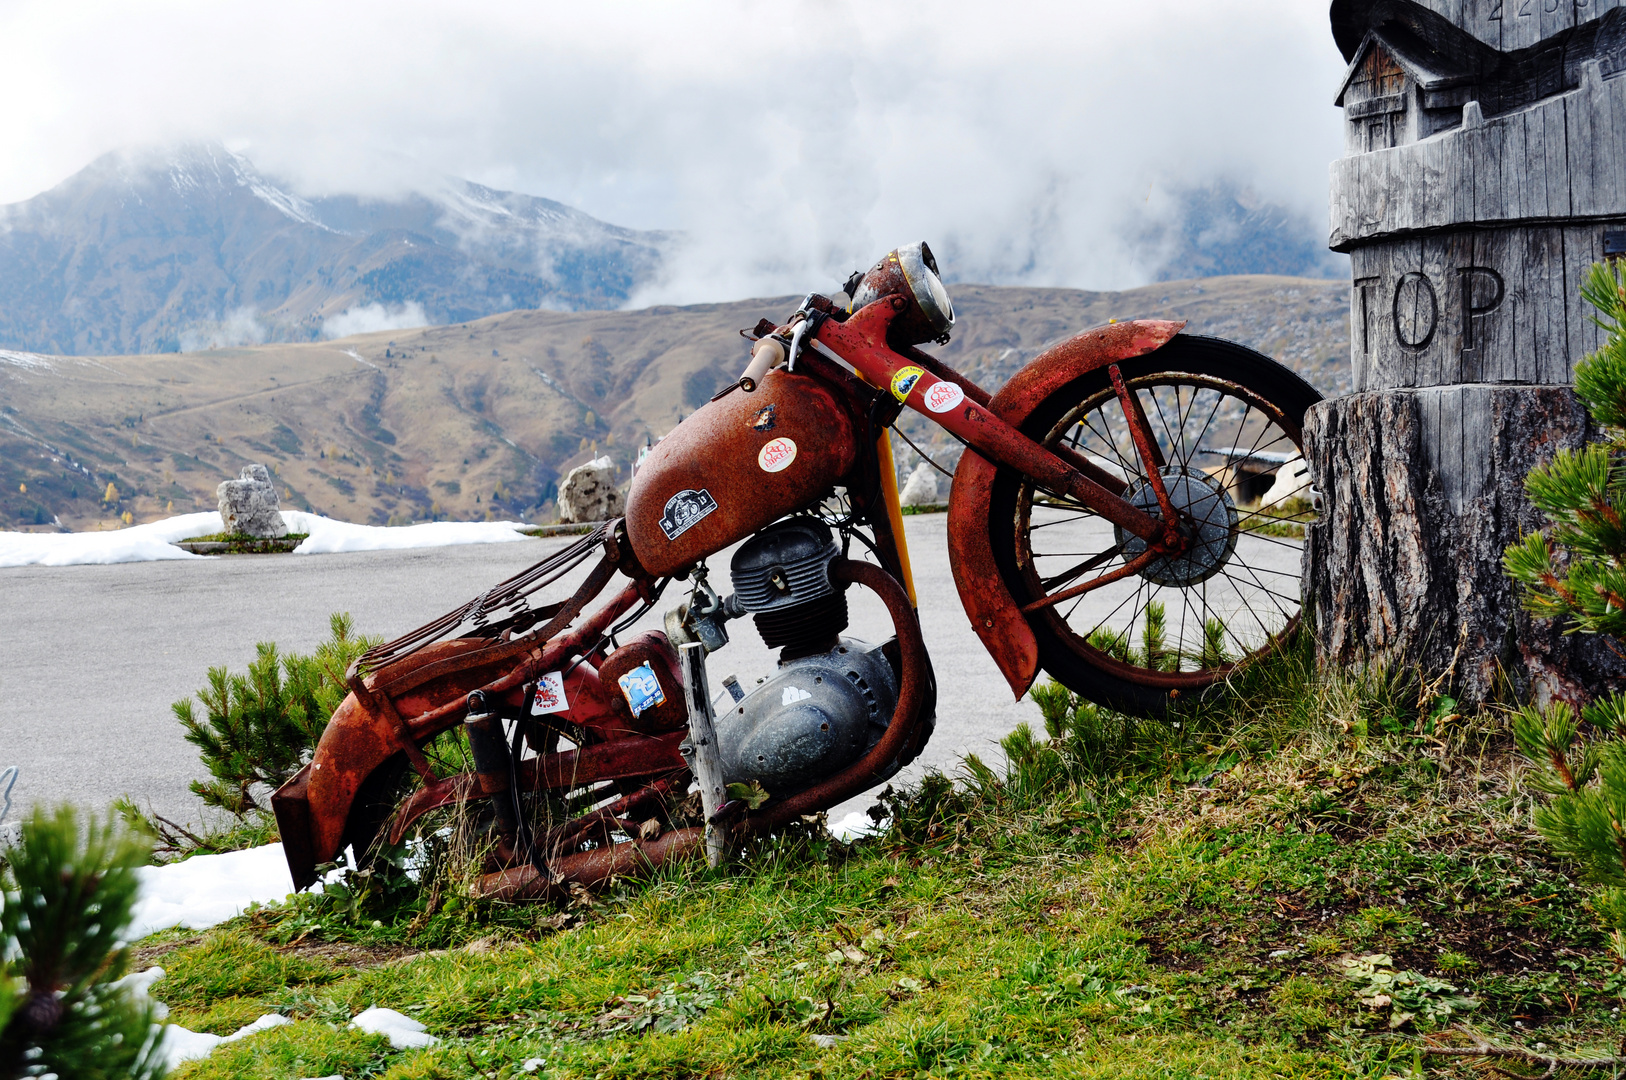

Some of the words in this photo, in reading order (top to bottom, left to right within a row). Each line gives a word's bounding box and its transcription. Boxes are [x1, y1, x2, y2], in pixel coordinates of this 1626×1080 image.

[1354, 267, 1504, 355] TOP
[931, 390, 959, 408] BIKER
[765, 446, 793, 468] BIKER
